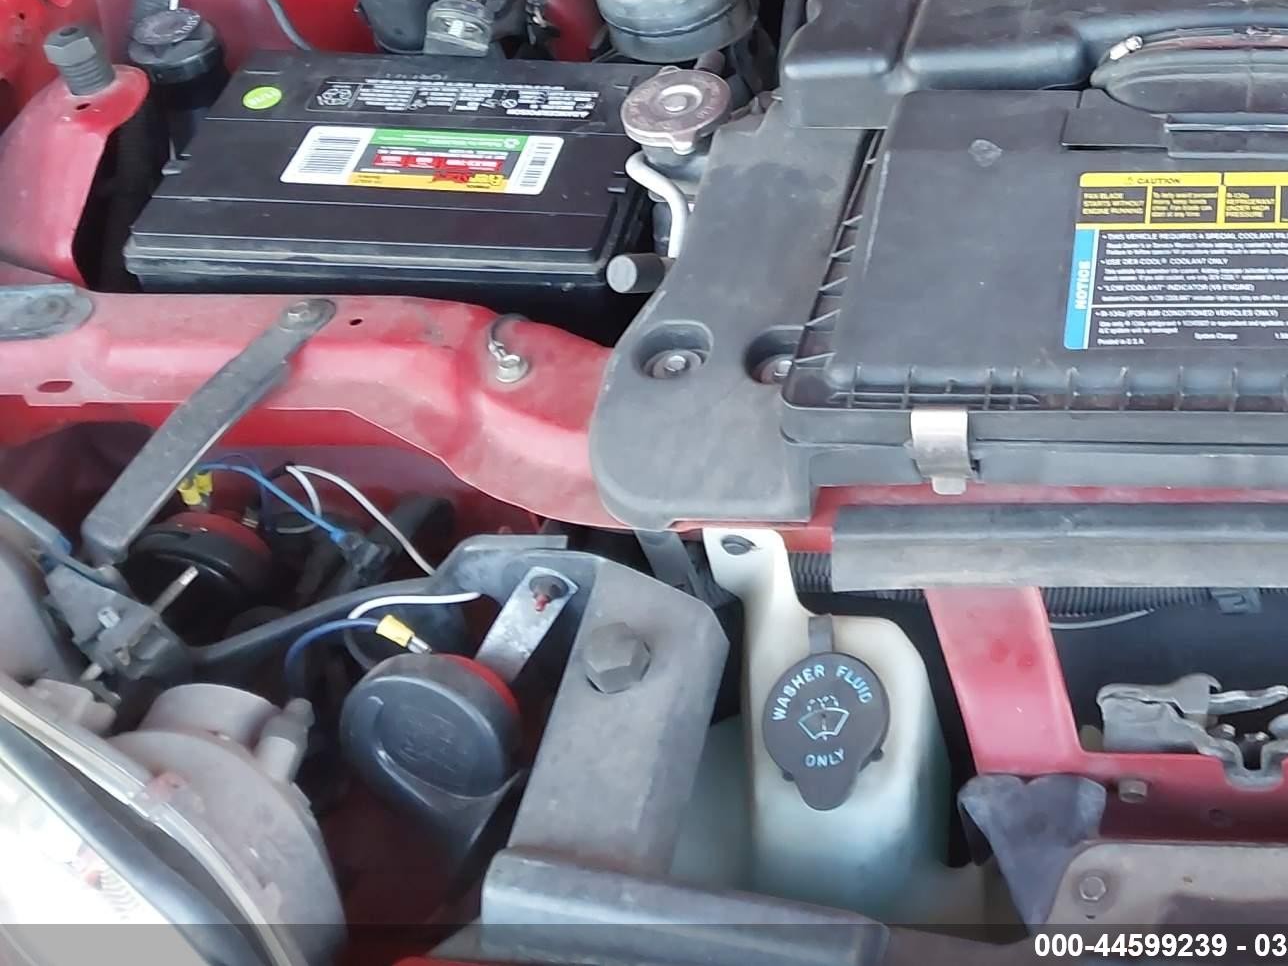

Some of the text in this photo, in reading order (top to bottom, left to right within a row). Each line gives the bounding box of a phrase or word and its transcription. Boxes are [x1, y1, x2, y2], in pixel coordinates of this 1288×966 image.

[1136, 177, 1181, 185] CAUTION
[1205, 232, 1237, 240] SPECIAL
[1237, 232, 1275, 240] COOLANT
[836, 665, 873, 704] FLUID
[805, 748, 845, 767] ONLY
